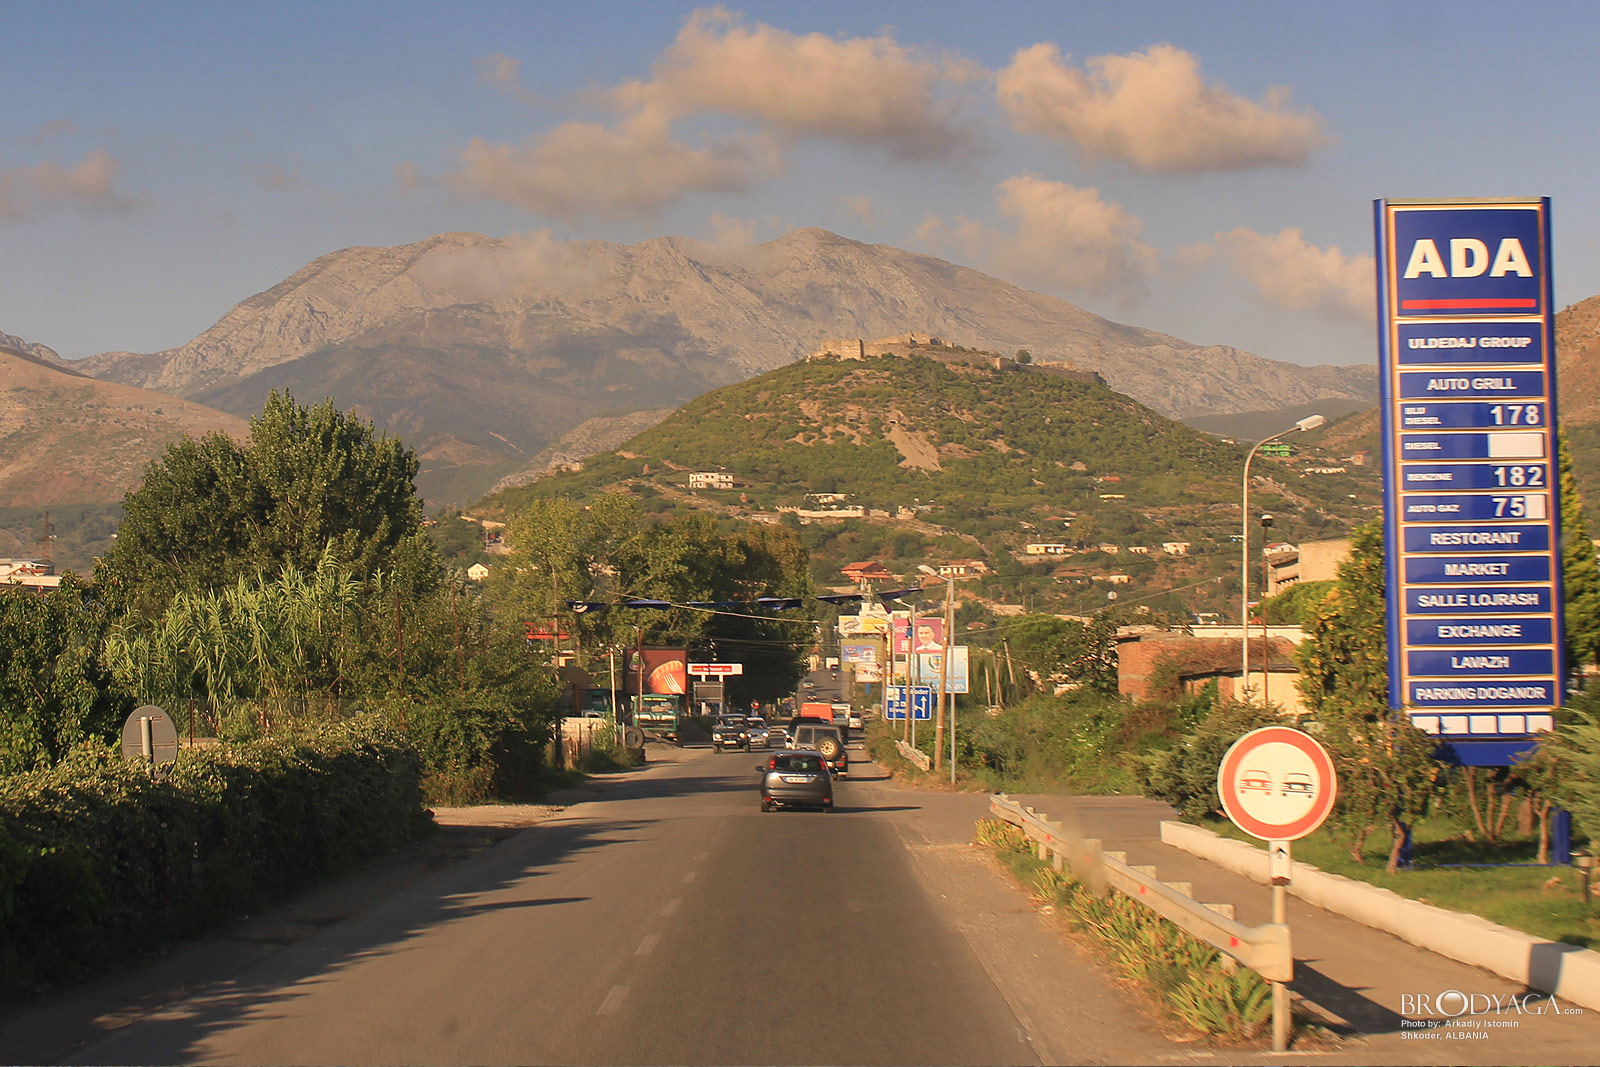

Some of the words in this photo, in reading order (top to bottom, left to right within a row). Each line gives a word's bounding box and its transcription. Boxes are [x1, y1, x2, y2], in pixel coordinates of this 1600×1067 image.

[1403, 237, 1534, 279] ADA
[1408, 337, 1477, 349] ULDEDAJ
[1478, 336, 1532, 348] GROUP
[1426, 378, 1470, 391] AUTO
[1471, 377, 1518, 390] GRILL
[1404, 416, 1442, 425] DIESEL
[1490, 405, 1540, 425] 178
[1404, 441, 1442, 450] DIESEL
[1494, 466, 1544, 486] 182
[1407, 504, 1437, 513] AUTO
[1437, 503, 1461, 512] GAZ
[1492, 497, 1526, 517] 75
[1430, 531, 1521, 545] RESTORANT
[1444, 562, 1510, 576] MARKET
[1418, 594, 1468, 608] SALLE
[1437, 624, 1522, 638] EXCHANGE
[1451, 656, 1510, 669] LAVAZH
[1415, 687, 1477, 700] PARKING
[1477, 686, 1547, 700] DOGANOR
